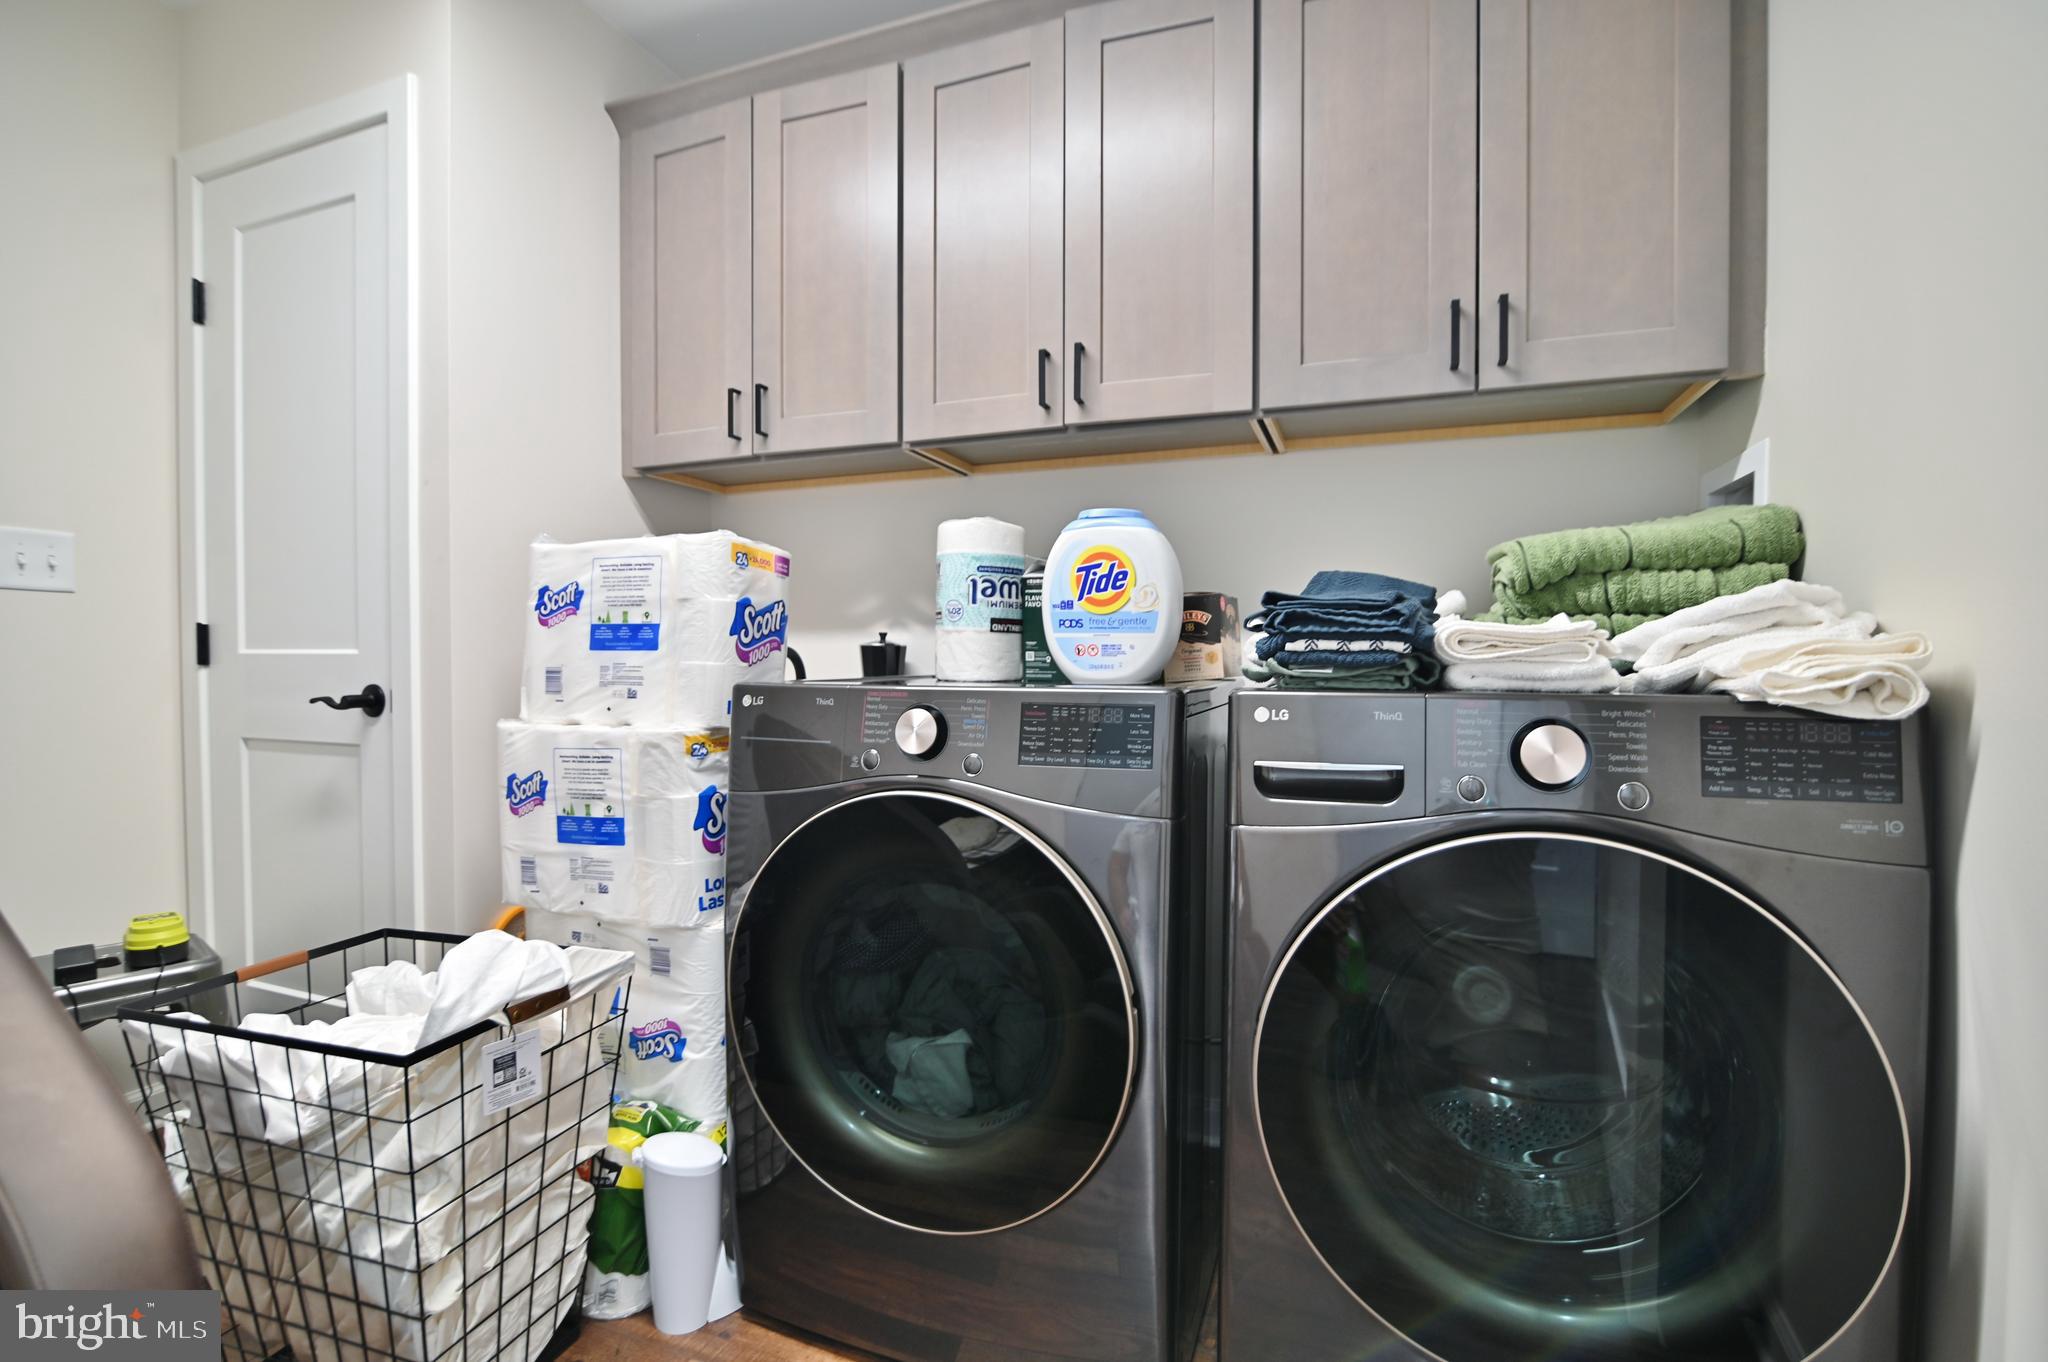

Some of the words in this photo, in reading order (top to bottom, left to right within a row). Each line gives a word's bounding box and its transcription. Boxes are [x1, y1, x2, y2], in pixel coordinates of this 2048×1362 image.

[1075, 561, 1129, 602] Tide
[540, 582, 577, 614] Scott
[970, 578, 1023, 605] wel
[740, 601, 784, 644] Scott
[1058, 619, 1084, 628] PODS
[1089, 617, 1106, 625] free
[1117, 617, 1148, 628] gentle
[1184, 612, 1207, 622] ILEYS
[748, 643, 771, 665] 1000
[752, 696, 764, 705] LG
[816, 697, 834, 706] ThinQ
[1271, 708, 1289, 721] LG
[1373, 711, 1403, 721] ThinQ
[1601, 710, 1622, 718] Bright
[1616, 720, 1647, 728] Delicates
[511, 771, 542, 804] Scott
[644, 1019, 669, 1034] 1000
[637, 1033, 679, 1059] Scott
